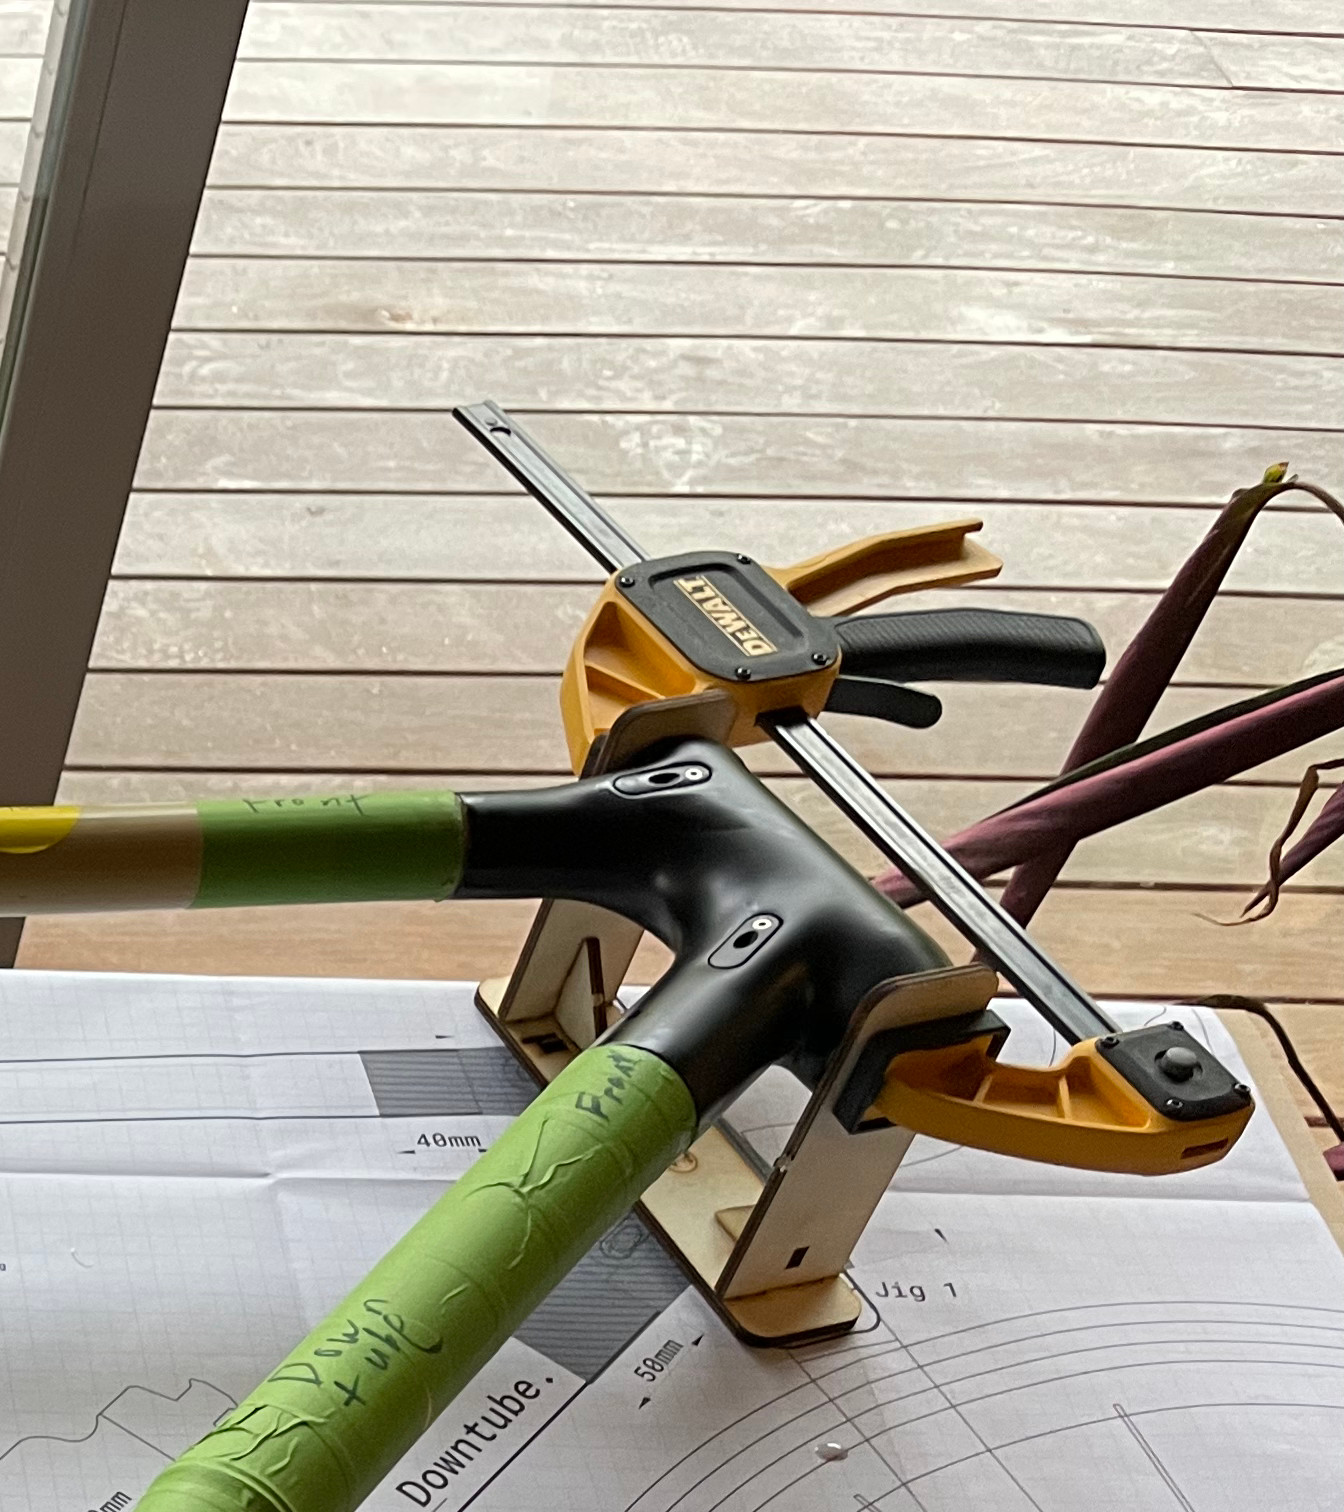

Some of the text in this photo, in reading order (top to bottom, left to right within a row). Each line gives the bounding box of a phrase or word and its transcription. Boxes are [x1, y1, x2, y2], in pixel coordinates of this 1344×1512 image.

[674, 576, 777, 657] DEWALT
[416, 1131, 482, 1150] 40mm
[875, 1281, 957, 1303] Jig 1
[633, 1336, 684, 1384] 50mm
[394, 1371, 555, 1508] Downtube.
